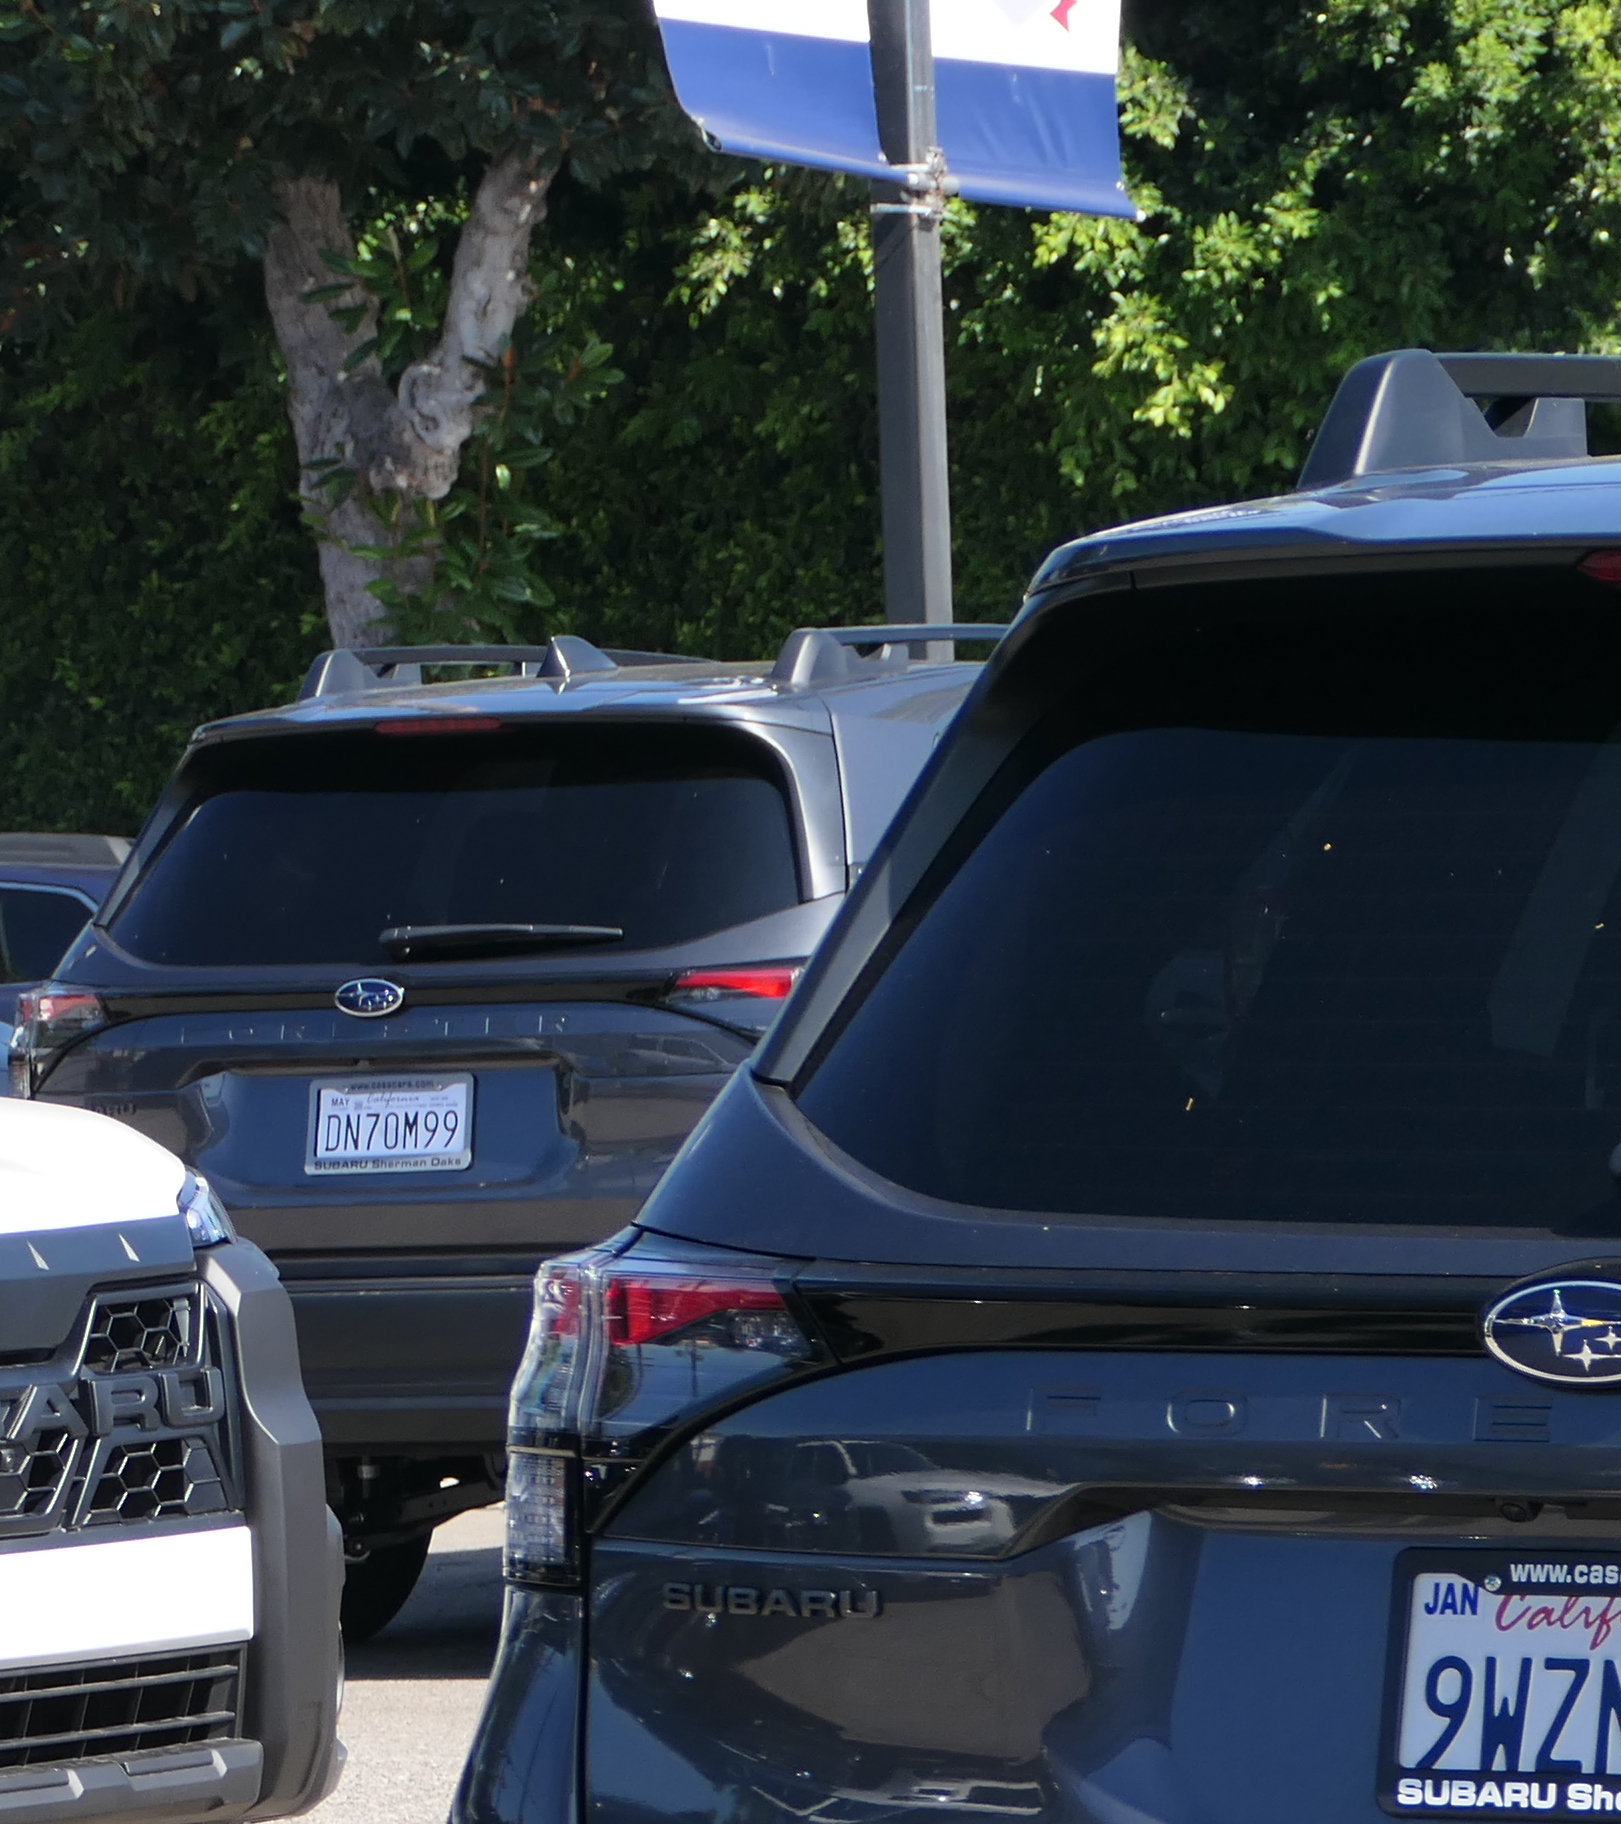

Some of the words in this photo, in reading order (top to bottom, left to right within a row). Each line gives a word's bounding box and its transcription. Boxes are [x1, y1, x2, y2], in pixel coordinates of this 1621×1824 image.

[331, 1097, 350, 1108] MAY
[325, 1110, 459, 1153] DN70M99
[313, 1159, 368, 1171] SUBARU
[371, 1158, 426, 1170] Sherman
[430, 1157, 461, 1167] Oaks
[0, 1365, 226, 1440] ARU
[661, 1581, 883, 1620] SUBARU
[1423, 1582, 1479, 1616] JAN
[1397, 1777, 1557, 1810] SUBARU
